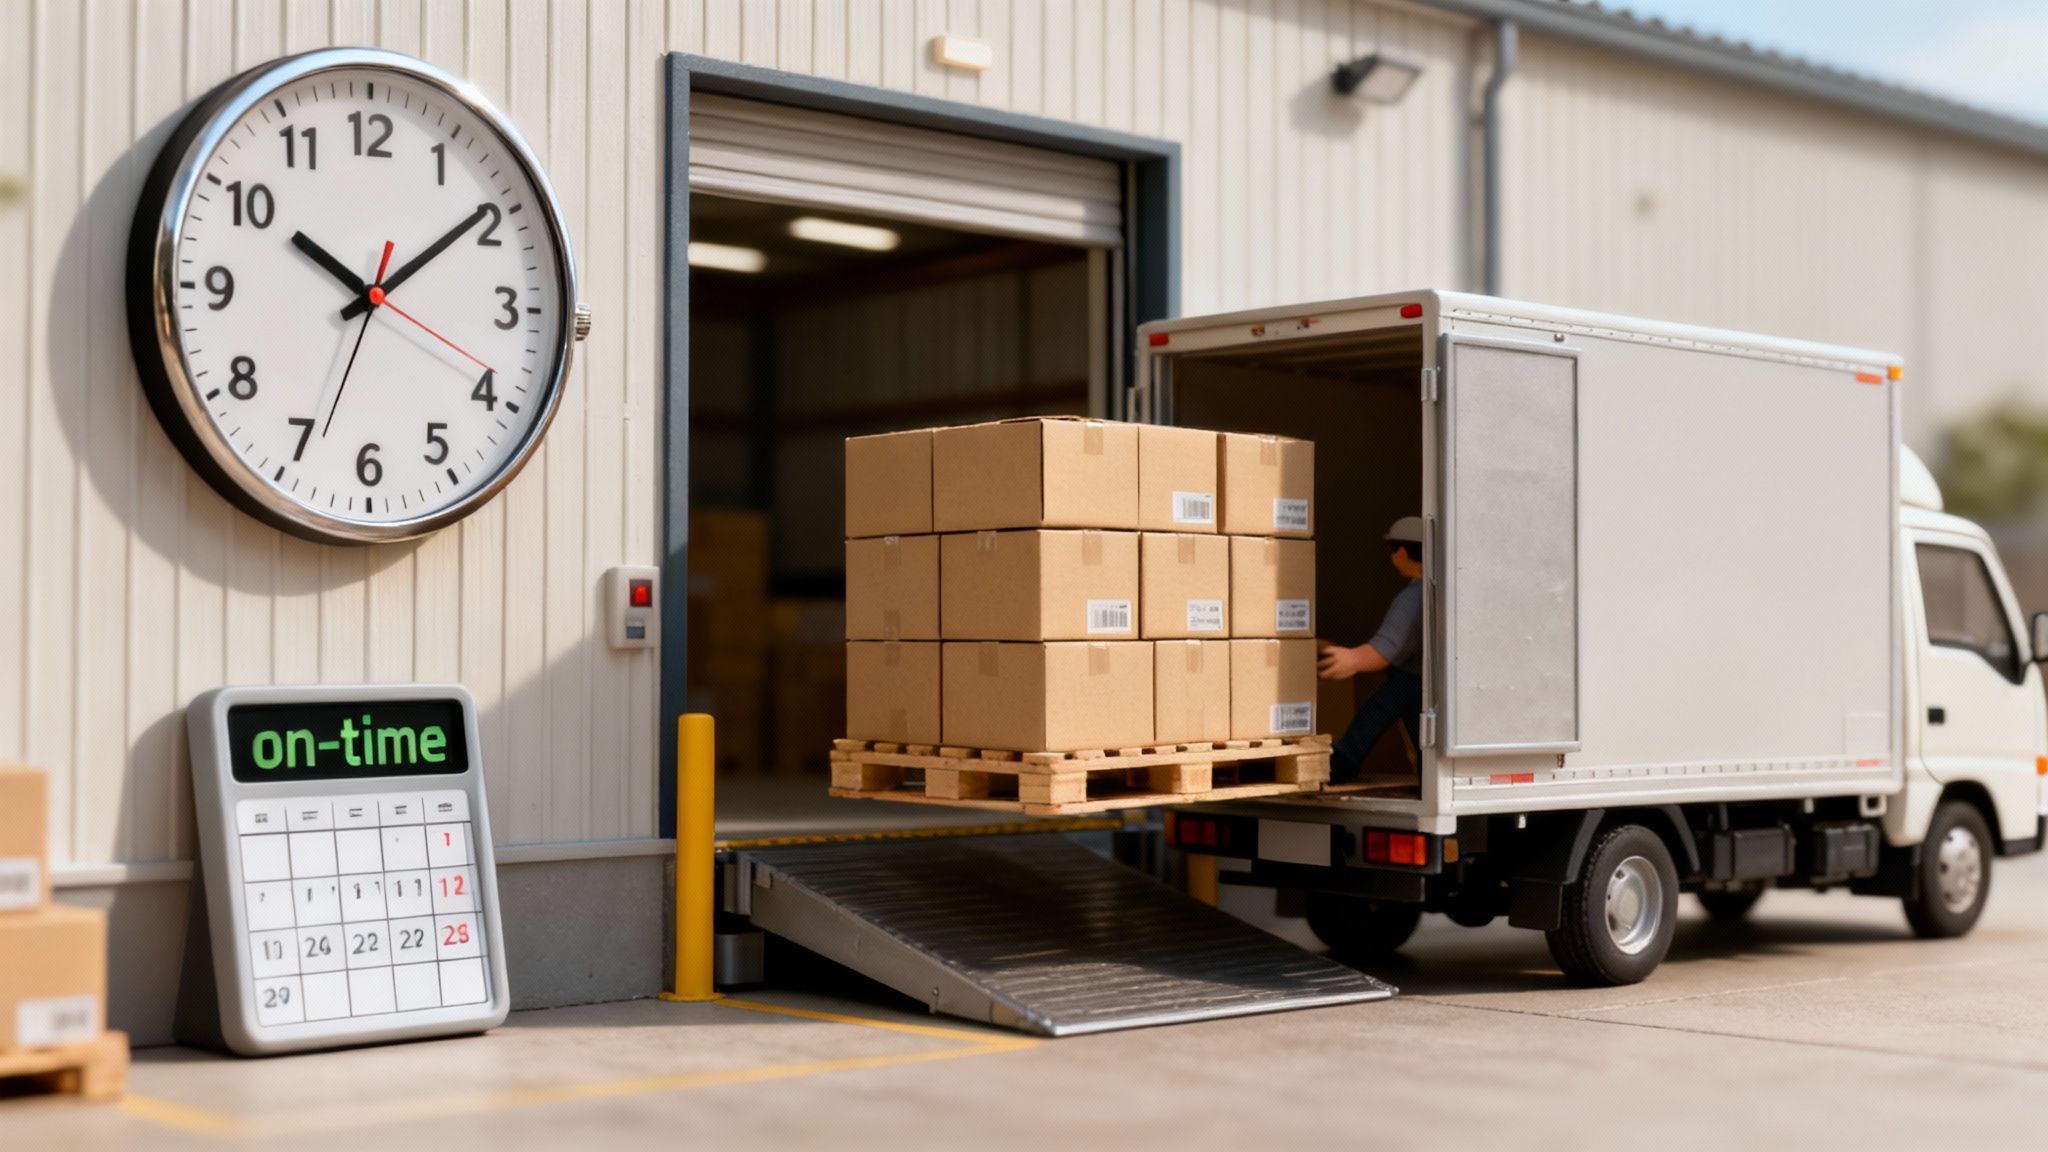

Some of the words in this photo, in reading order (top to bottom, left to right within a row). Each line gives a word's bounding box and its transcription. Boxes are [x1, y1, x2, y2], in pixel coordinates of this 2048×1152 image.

[279, 125, 317, 170] 11
[348, 111, 393, 158] 12
[430, 143, 446, 185] 1
[226, 181, 275, 229] 10
[476, 202, 502, 246] 2
[205, 266, 234, 311] 9
[494, 286, 519, 330] 3
[228, 356, 258, 400] 8
[471, 368, 498, 411] 4
[288, 418, 315, 461] 7
[424, 423, 449, 465] 5
[356, 443, 383, 486] 6
[252, 714, 447, 770] on-time
[439, 875, 465, 898] 12
[352, 932, 379, 955] 22
